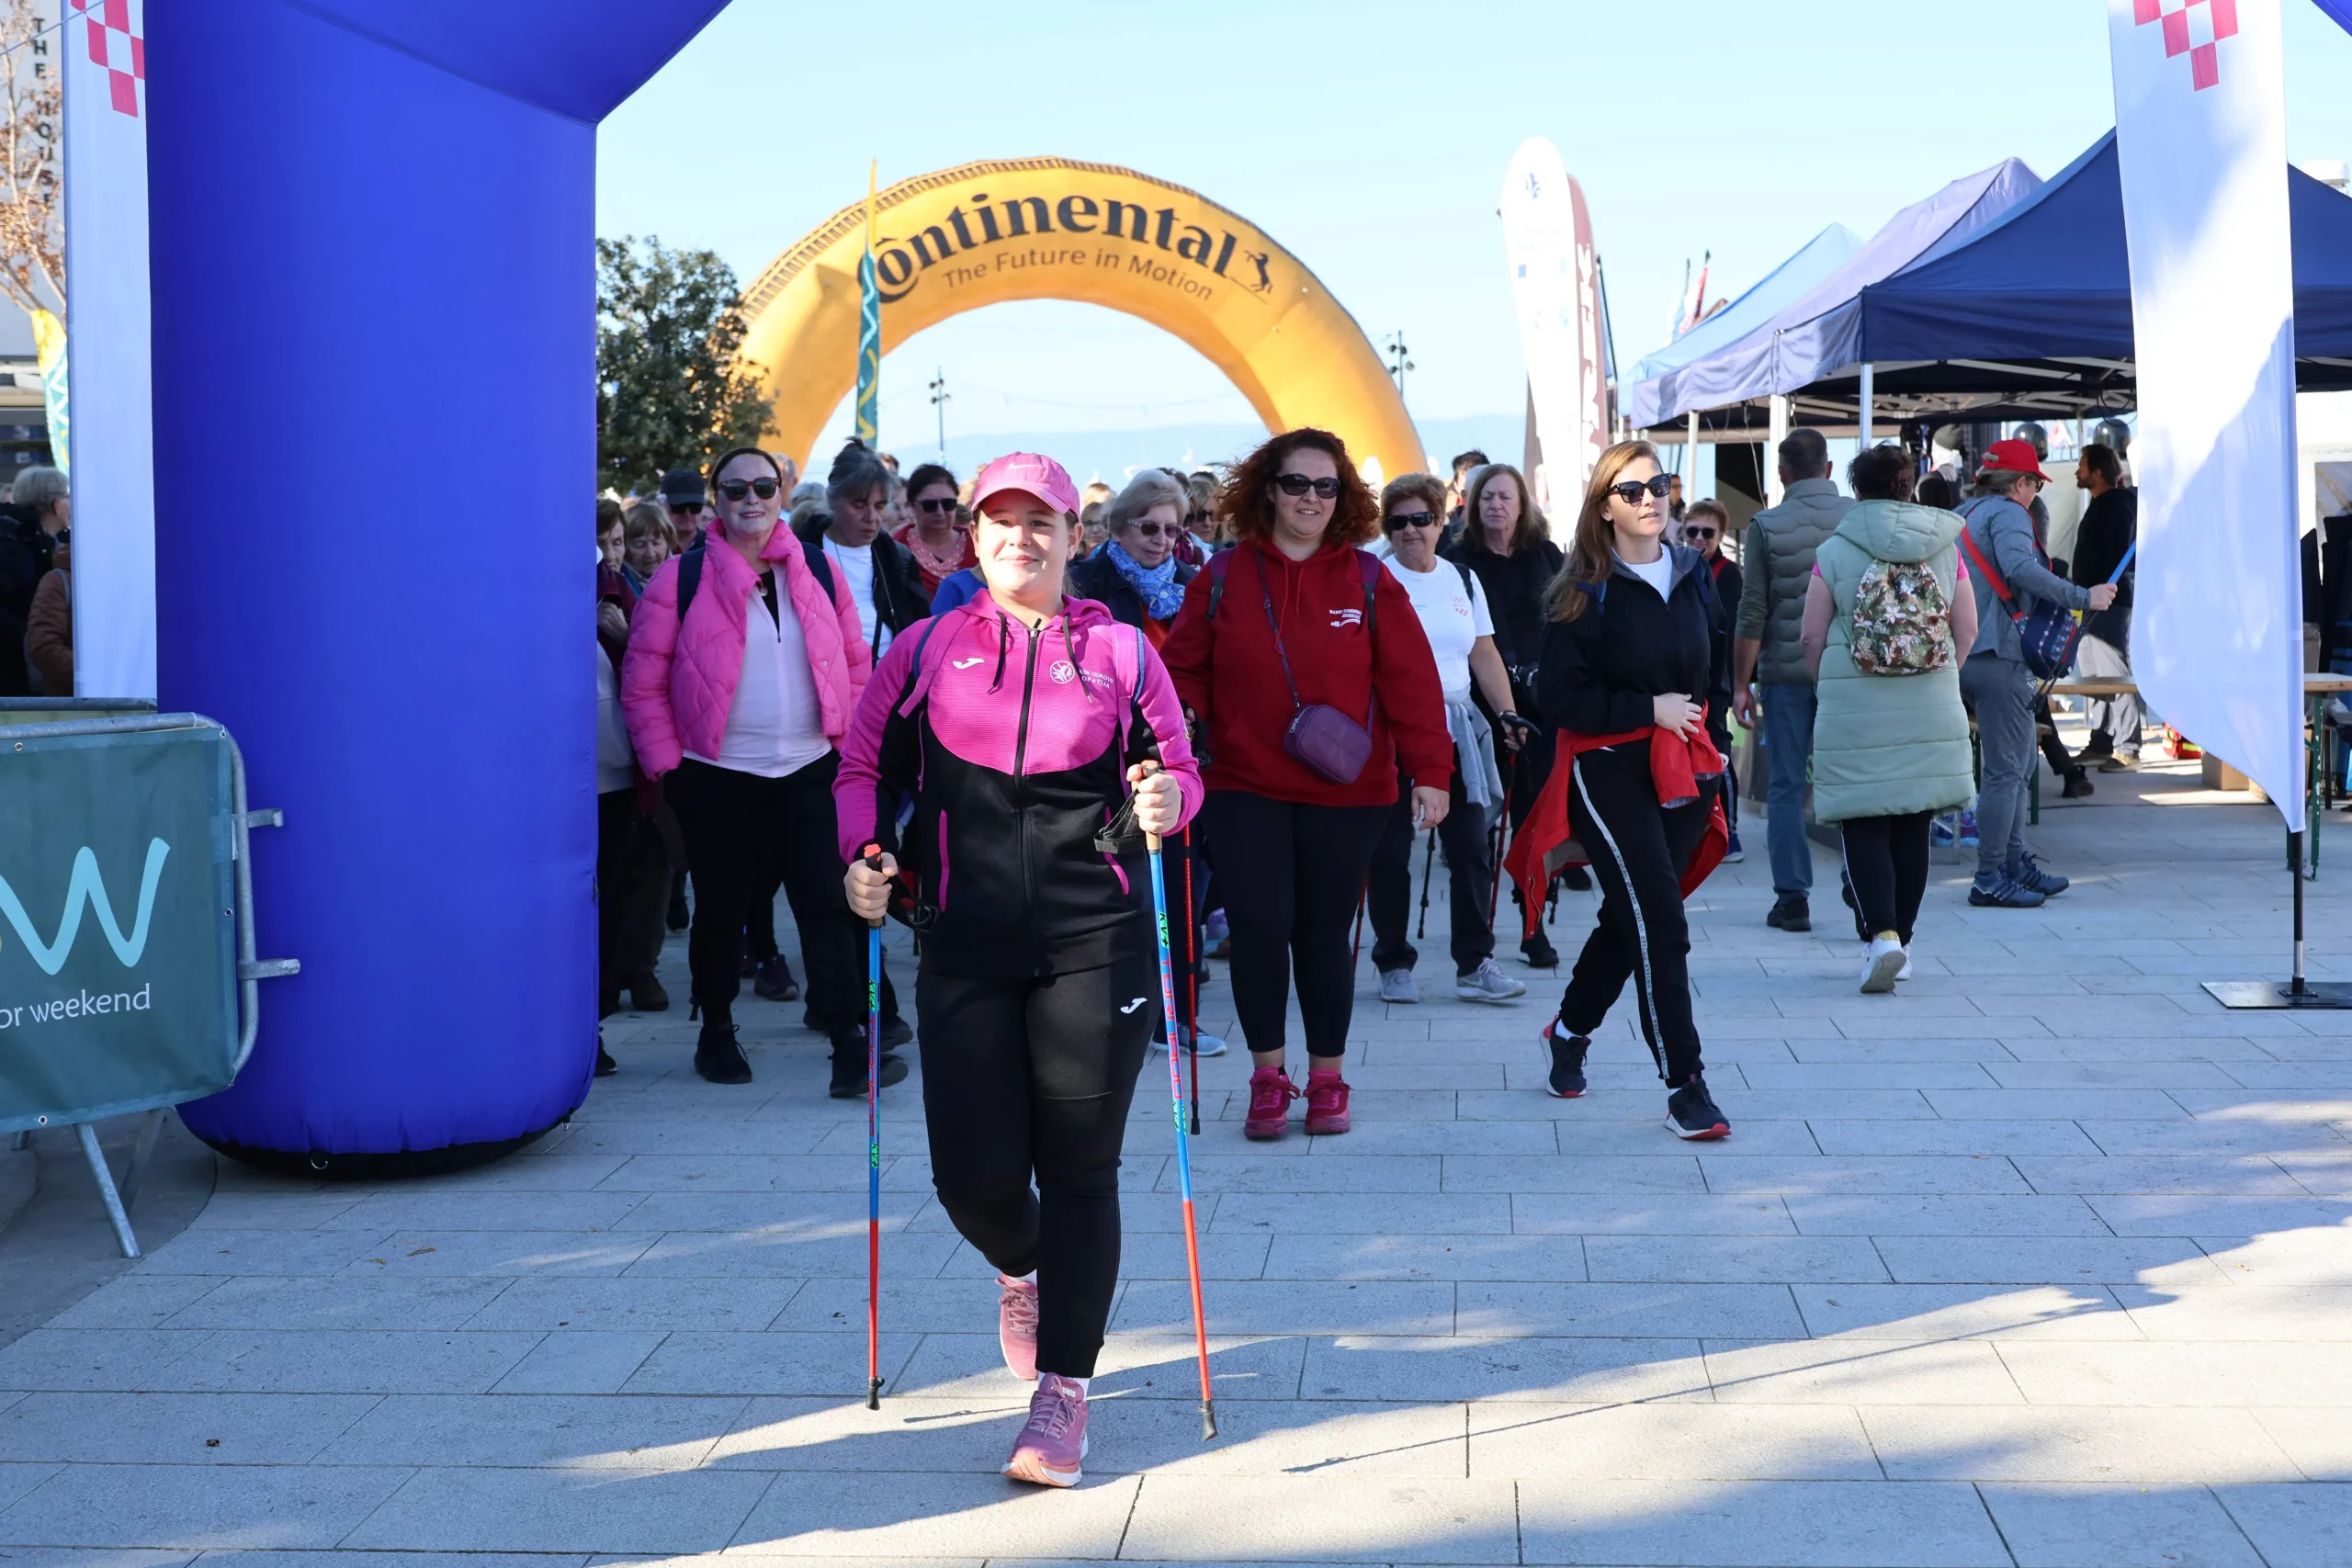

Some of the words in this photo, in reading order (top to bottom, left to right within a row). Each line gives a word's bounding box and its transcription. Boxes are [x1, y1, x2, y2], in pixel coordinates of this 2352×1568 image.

[32, 17, 47, 79] THE
[856, 193, 1238, 304] Continental
[943, 262, 988, 289] The
[996, 247, 1086, 270] Future
[1095, 246, 1120, 268] in
[1128, 254, 1214, 301] Motion
[1081, 675, 1110, 689] OPATIJA
[29, 982, 151, 1023] weekend
